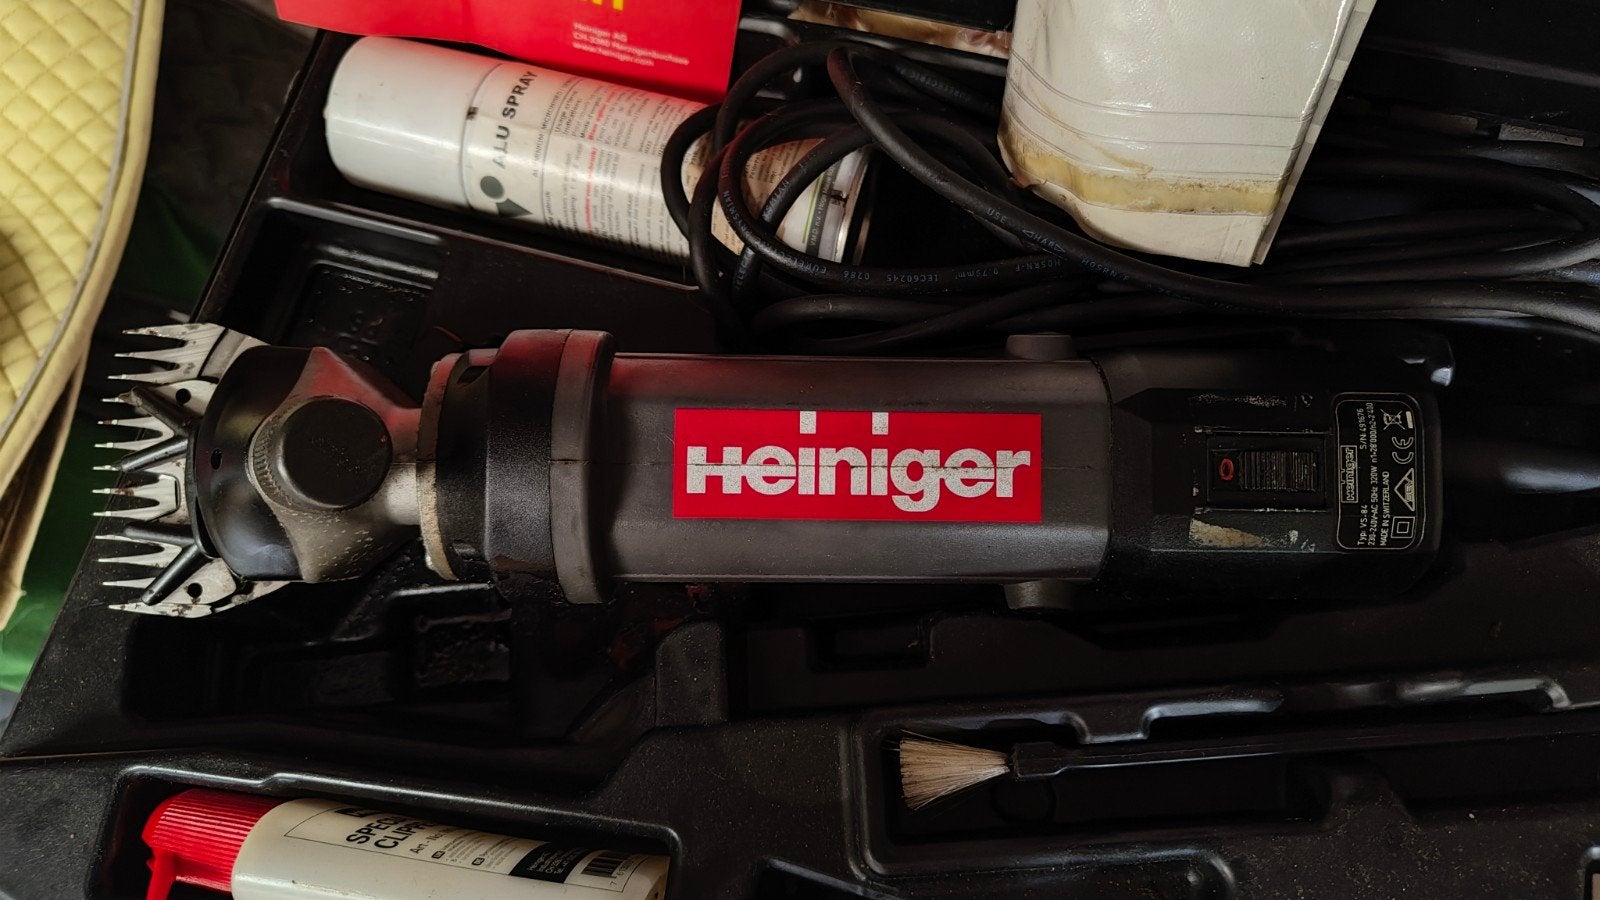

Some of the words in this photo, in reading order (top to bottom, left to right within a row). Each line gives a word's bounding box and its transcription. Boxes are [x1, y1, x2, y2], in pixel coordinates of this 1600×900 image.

[493, 125, 511, 170] ALU
[502, 71, 538, 120] SPRAY
[686, 410, 1031, 513] Heiniger
[1342, 447, 1356, 501] Heiniger
[1382, 471, 1390, 519] SWITZERLAND
[1380, 528, 1390, 546] MADE
[1381, 517, 1389, 528] IN
